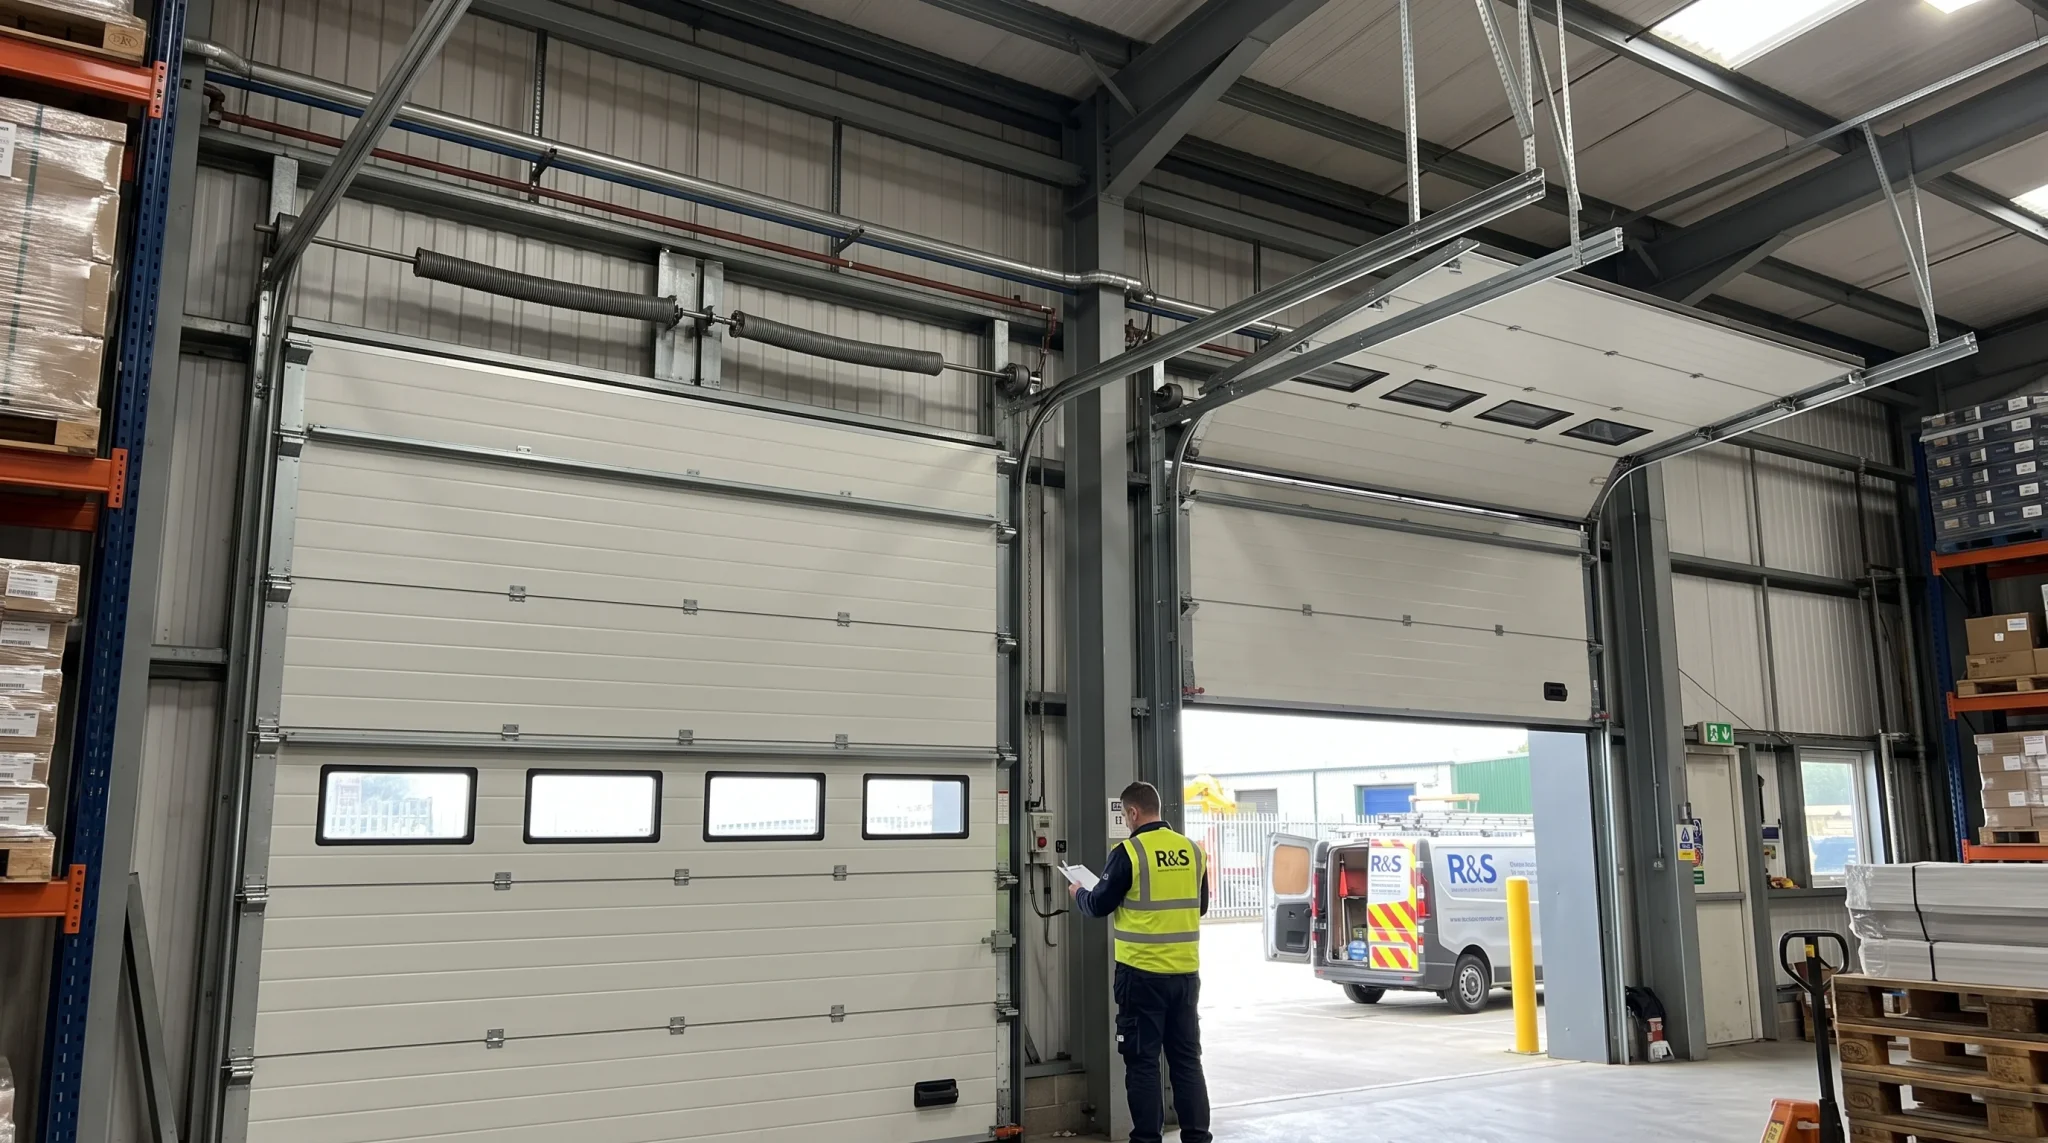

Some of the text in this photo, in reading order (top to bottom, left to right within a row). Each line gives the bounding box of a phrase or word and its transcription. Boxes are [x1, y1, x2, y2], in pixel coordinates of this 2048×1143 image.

[1155, 849, 1190, 867] R&S
[1371, 855, 1402, 873] R&S
[1447, 854, 1497, 884] R&S
